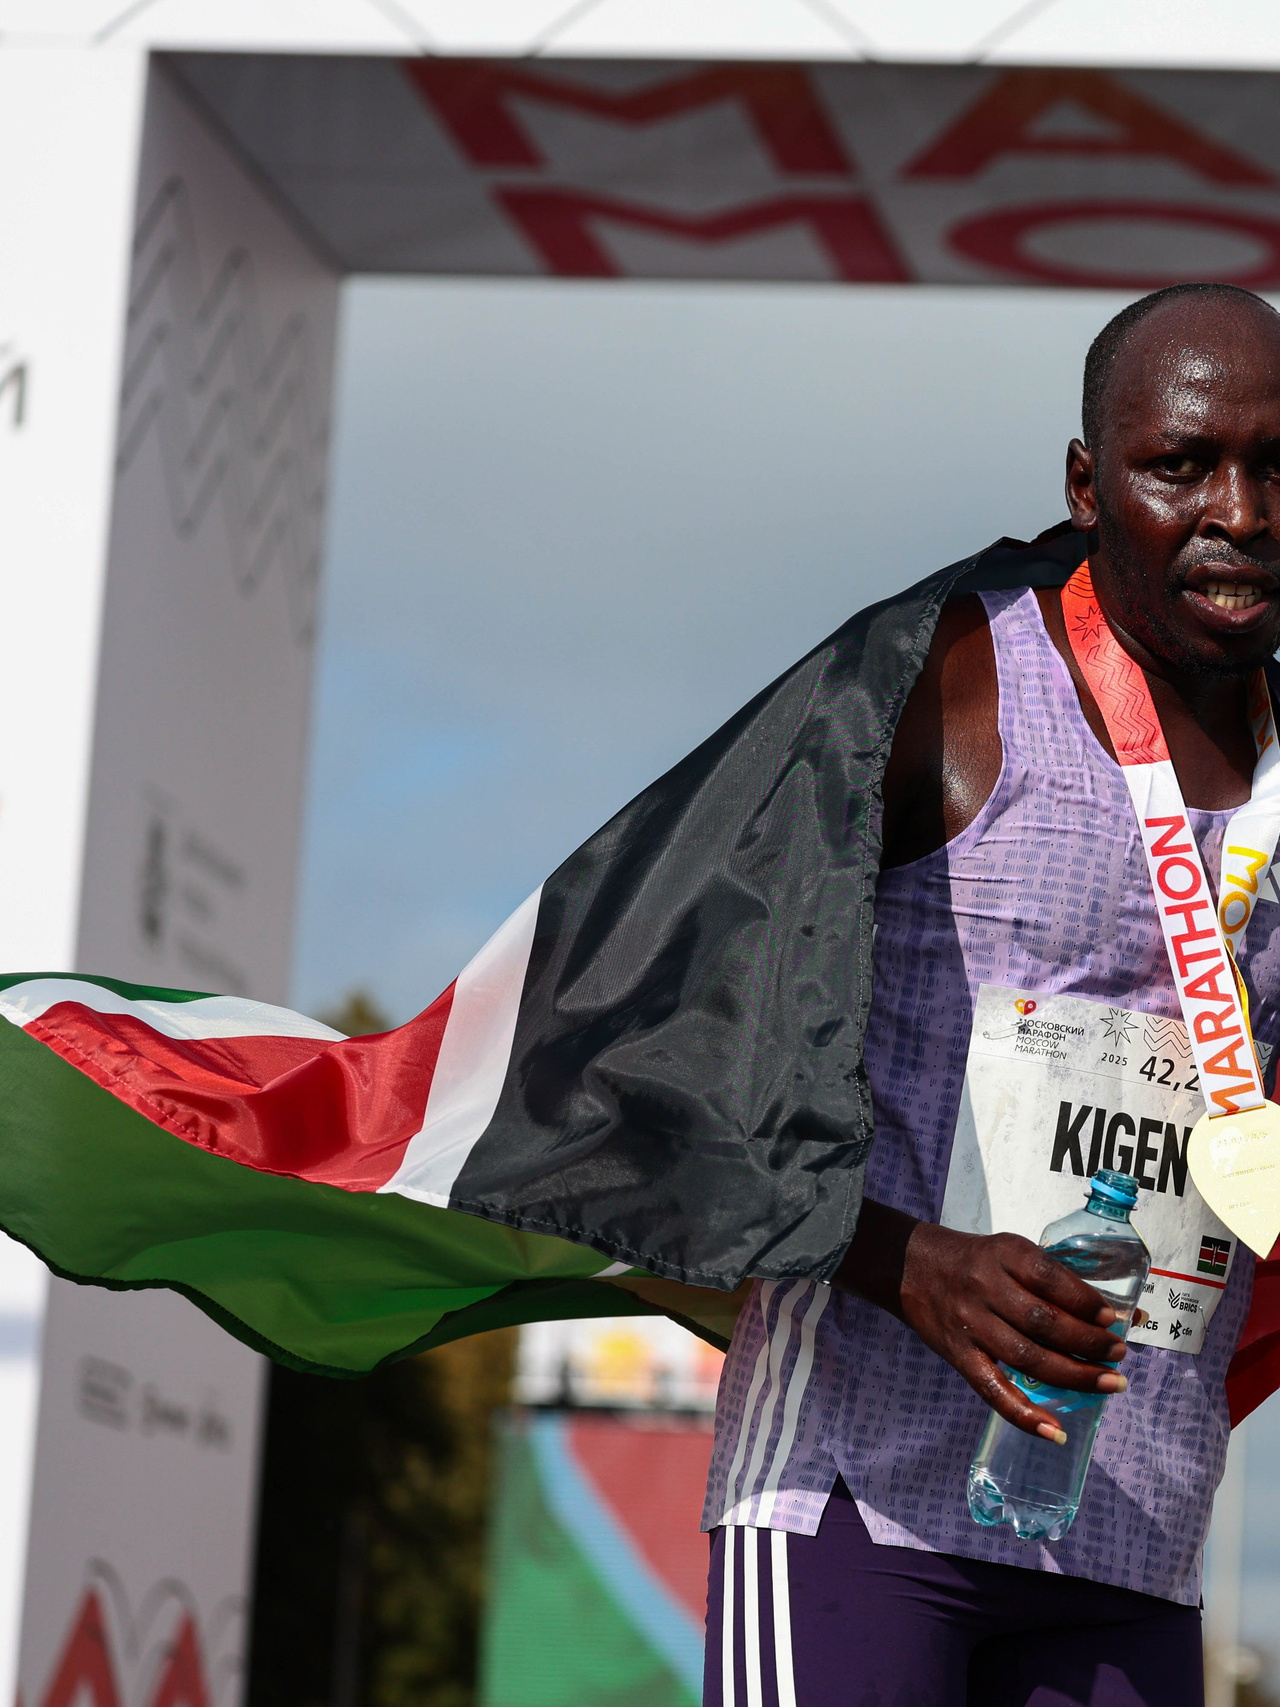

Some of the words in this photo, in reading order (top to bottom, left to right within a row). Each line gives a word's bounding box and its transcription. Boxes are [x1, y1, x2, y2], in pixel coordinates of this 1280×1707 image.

[1017, 1027, 1067, 1042] МАРАФОН
[1016, 1036, 1060, 1049] MOSCOW
[1014, 1044, 1067, 1060] MARATHON
[1101, 1052, 1128, 1066] 2025
[1139, 1056, 1200, 1092] 42,2
[1049, 1100, 1194, 1198] KIGEN
[1179, 1302, 1198, 1313] BRICS
[1139, 1320, 1159, 1331] СБ
